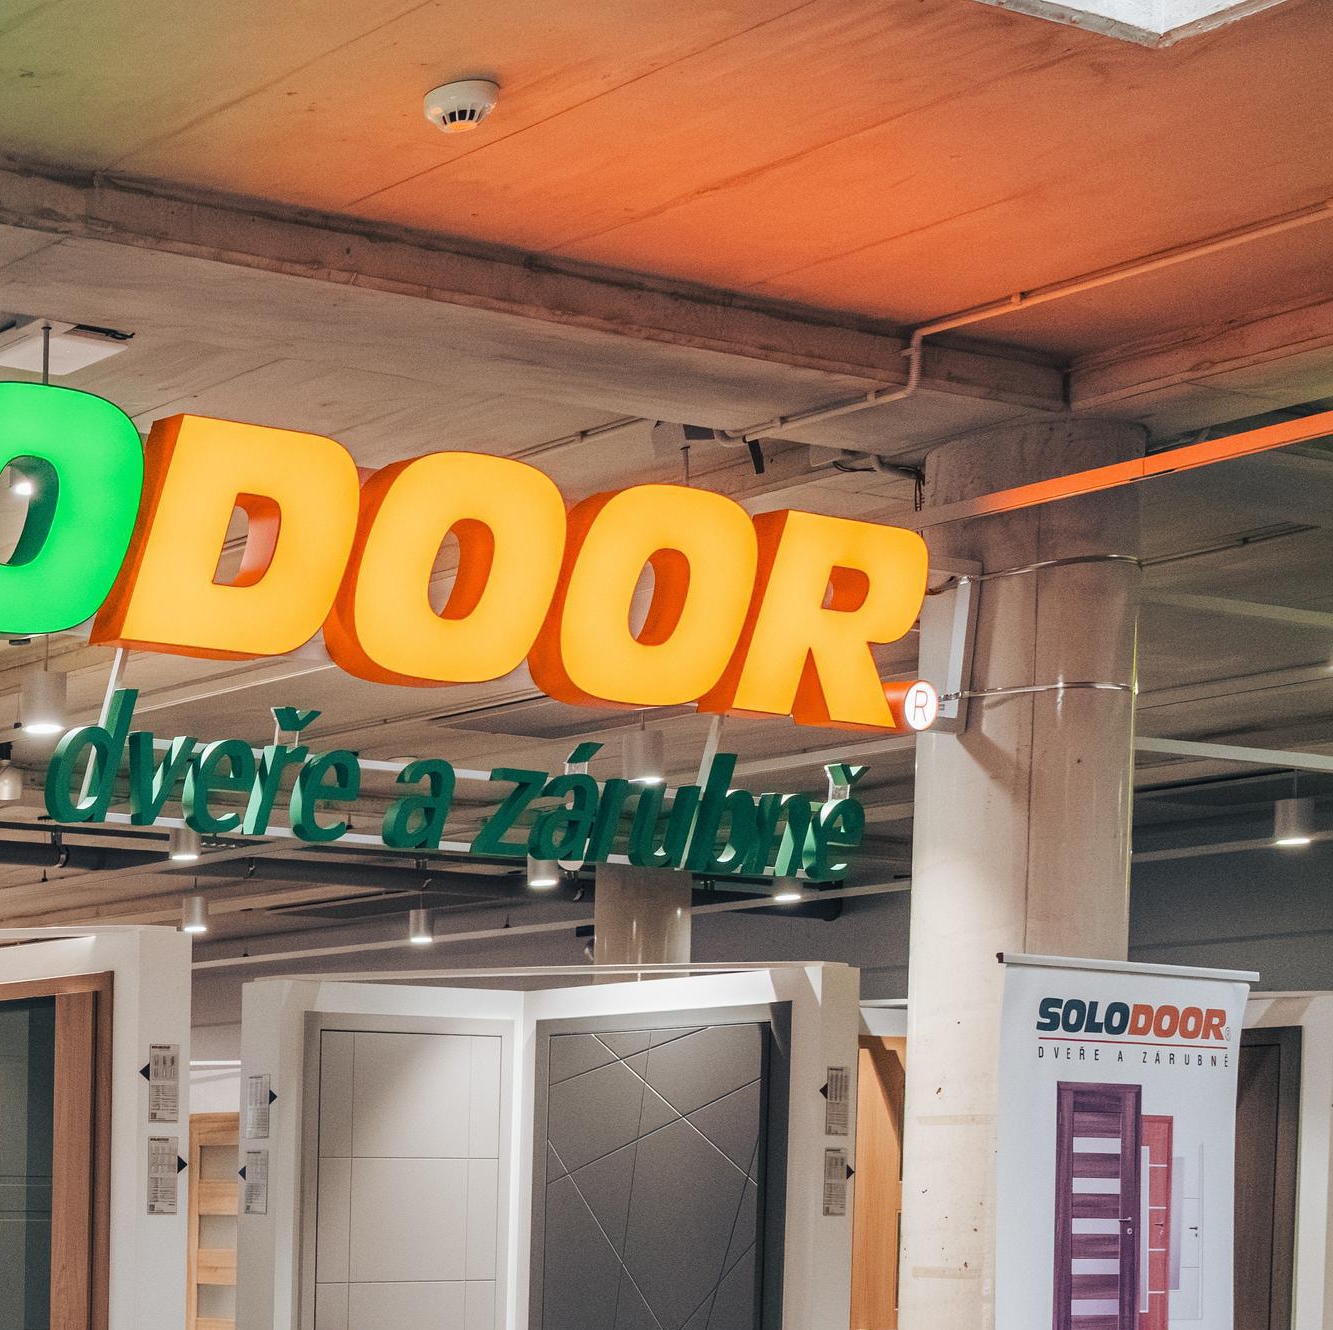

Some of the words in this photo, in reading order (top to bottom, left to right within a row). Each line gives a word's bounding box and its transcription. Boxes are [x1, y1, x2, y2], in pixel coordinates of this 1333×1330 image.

[44, 688, 361, 842] dveře
[381, 757, 456, 850] a
[469, 741, 871, 881] zárubně
[1036, 997, 1227, 1041] SOLODOOR
[1038, 1046, 1099, 1061] DVEŘE
[1117, 1051, 1123, 1062] A
